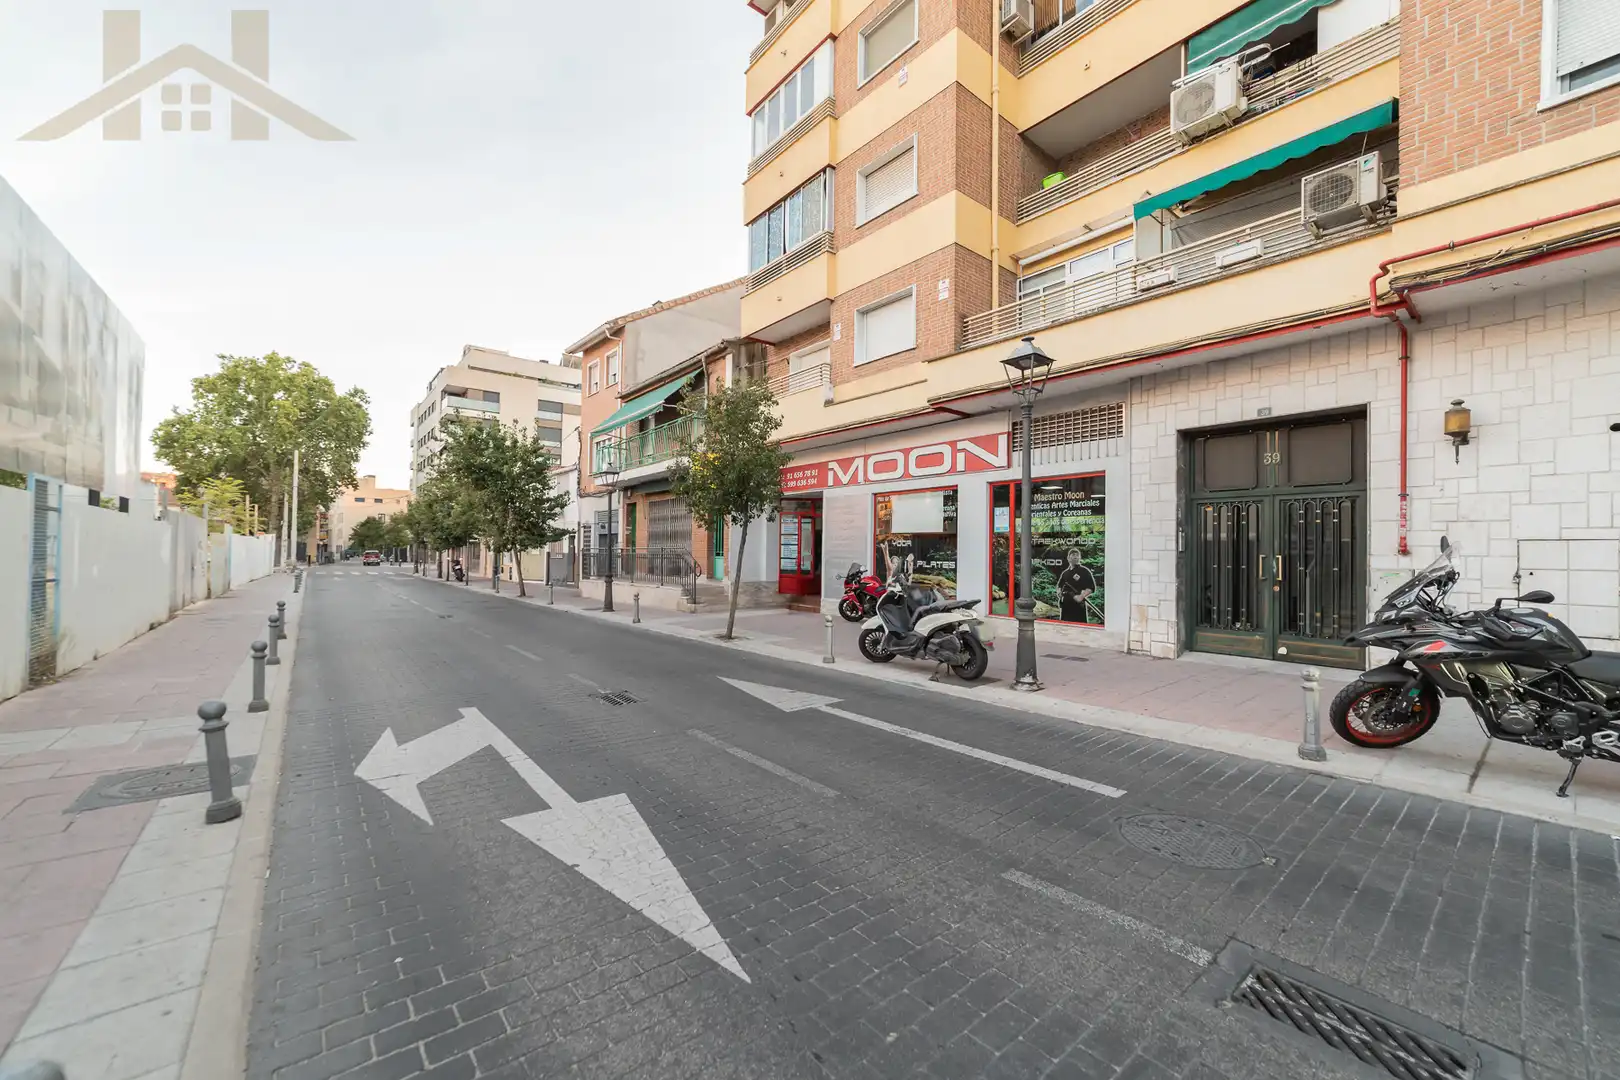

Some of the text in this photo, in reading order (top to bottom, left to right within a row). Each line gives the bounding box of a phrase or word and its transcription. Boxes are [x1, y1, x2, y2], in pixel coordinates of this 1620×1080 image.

[828, 434, 1008, 487] MOON
[1263, 452, 1281, 465] 39
[1034, 491, 1085, 502] Maestro Moon
[1069, 499, 1100, 508] Marciales
[1063, 508, 1092, 516] Coreanas
[1031, 537, 1096, 545] TAEKWONDO
[916, 560, 956, 569] PILATES
